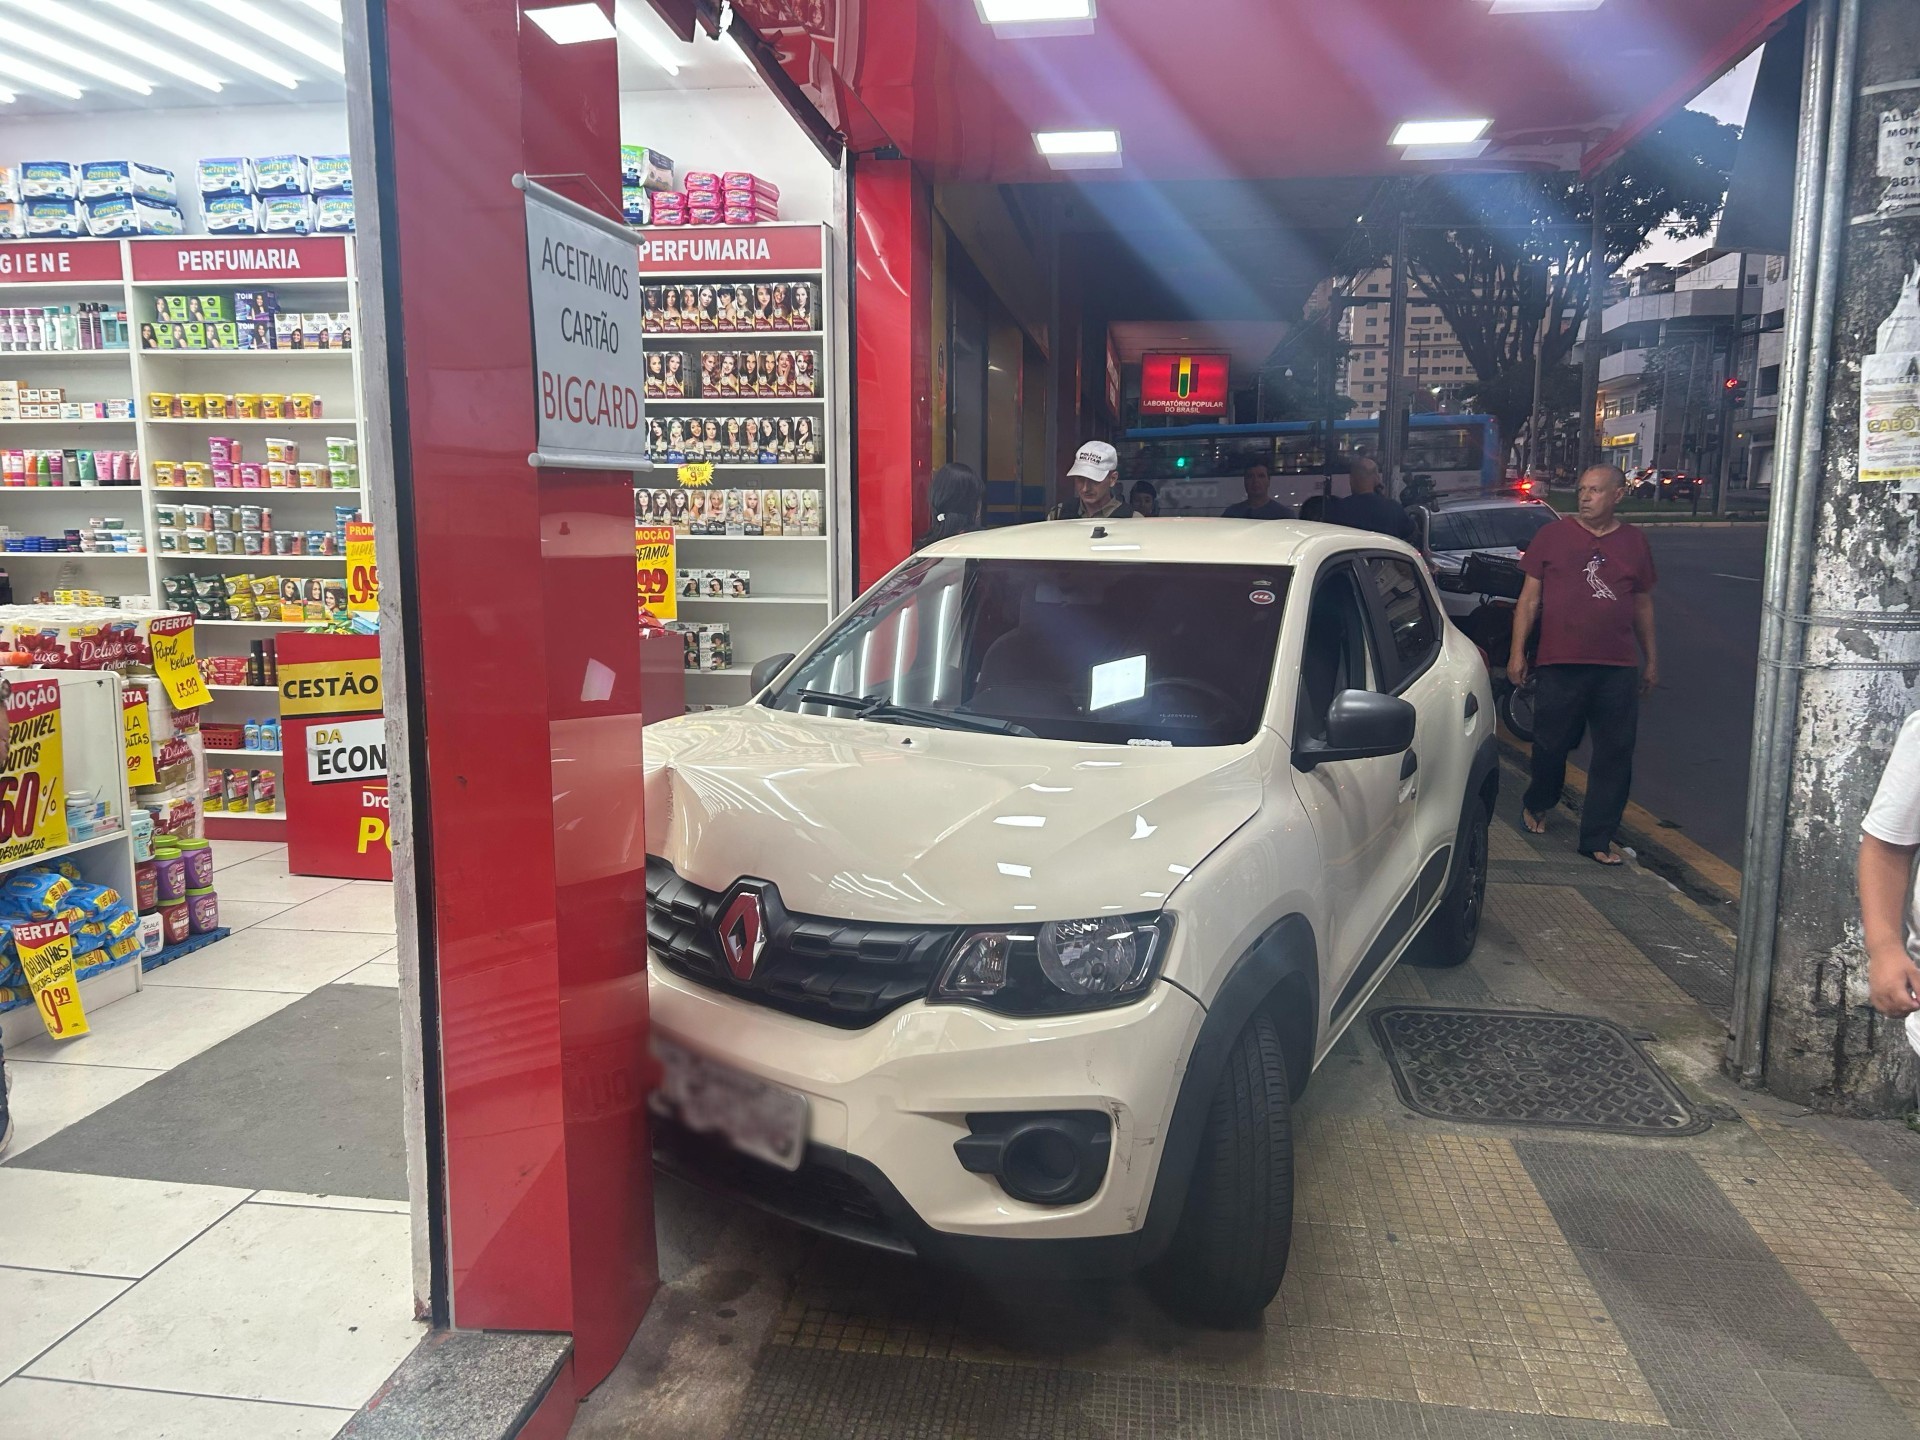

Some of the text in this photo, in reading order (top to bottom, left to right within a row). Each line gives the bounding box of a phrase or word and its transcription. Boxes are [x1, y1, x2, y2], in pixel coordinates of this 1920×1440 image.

[178, 248, 301, 272] PERFUMARIA
[639, 237, 771, 262] PERFUMARIA
[542, 236, 629, 301] ACEITAMOS
[561, 307, 619, 354] CARTÃO
[542, 370, 639, 430] BIGCARD
[1143, 399, 1223, 408] LABORATÓRIO POPULAR
[151, 615, 193, 633] OFERTA
[80, 640, 122, 662] Deluxe
[283, 672, 379, 700] CESTÃO
[316, 728, 343, 746] DA
[316, 744, 388, 776] ECON
